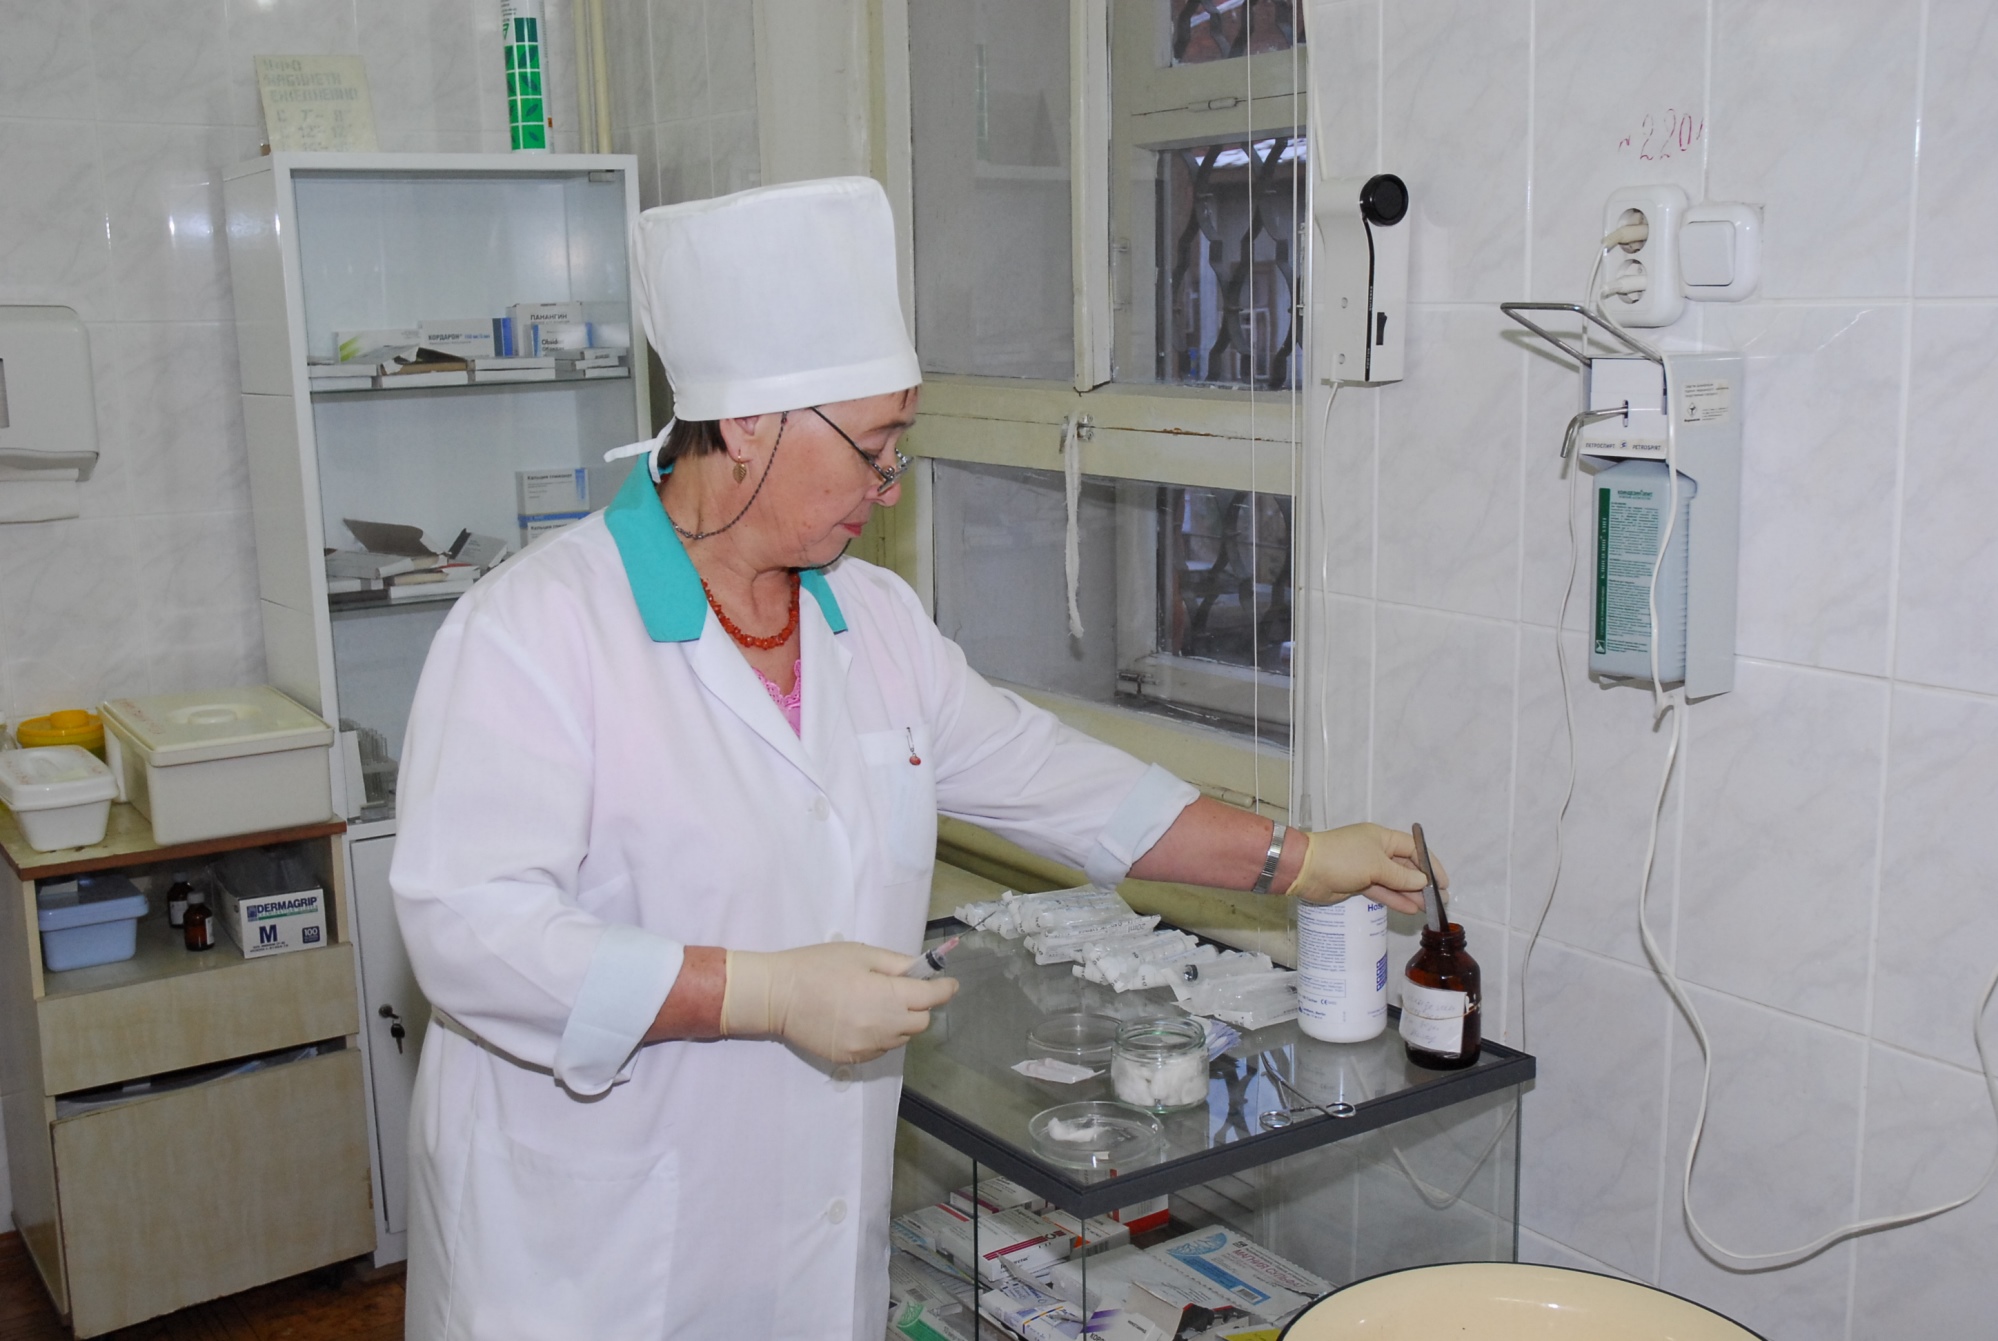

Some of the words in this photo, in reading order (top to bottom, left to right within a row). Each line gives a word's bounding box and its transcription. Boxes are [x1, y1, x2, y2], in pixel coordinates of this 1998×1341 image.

[530, 313, 568, 321] ПАНАНГИН
[257, 896, 318, 914] DERMAGRIP
[259, 924, 278, 944] M
[304, 927, 318, 936] 100
[1232, 1249, 1270, 1270] МАГНИЯ
